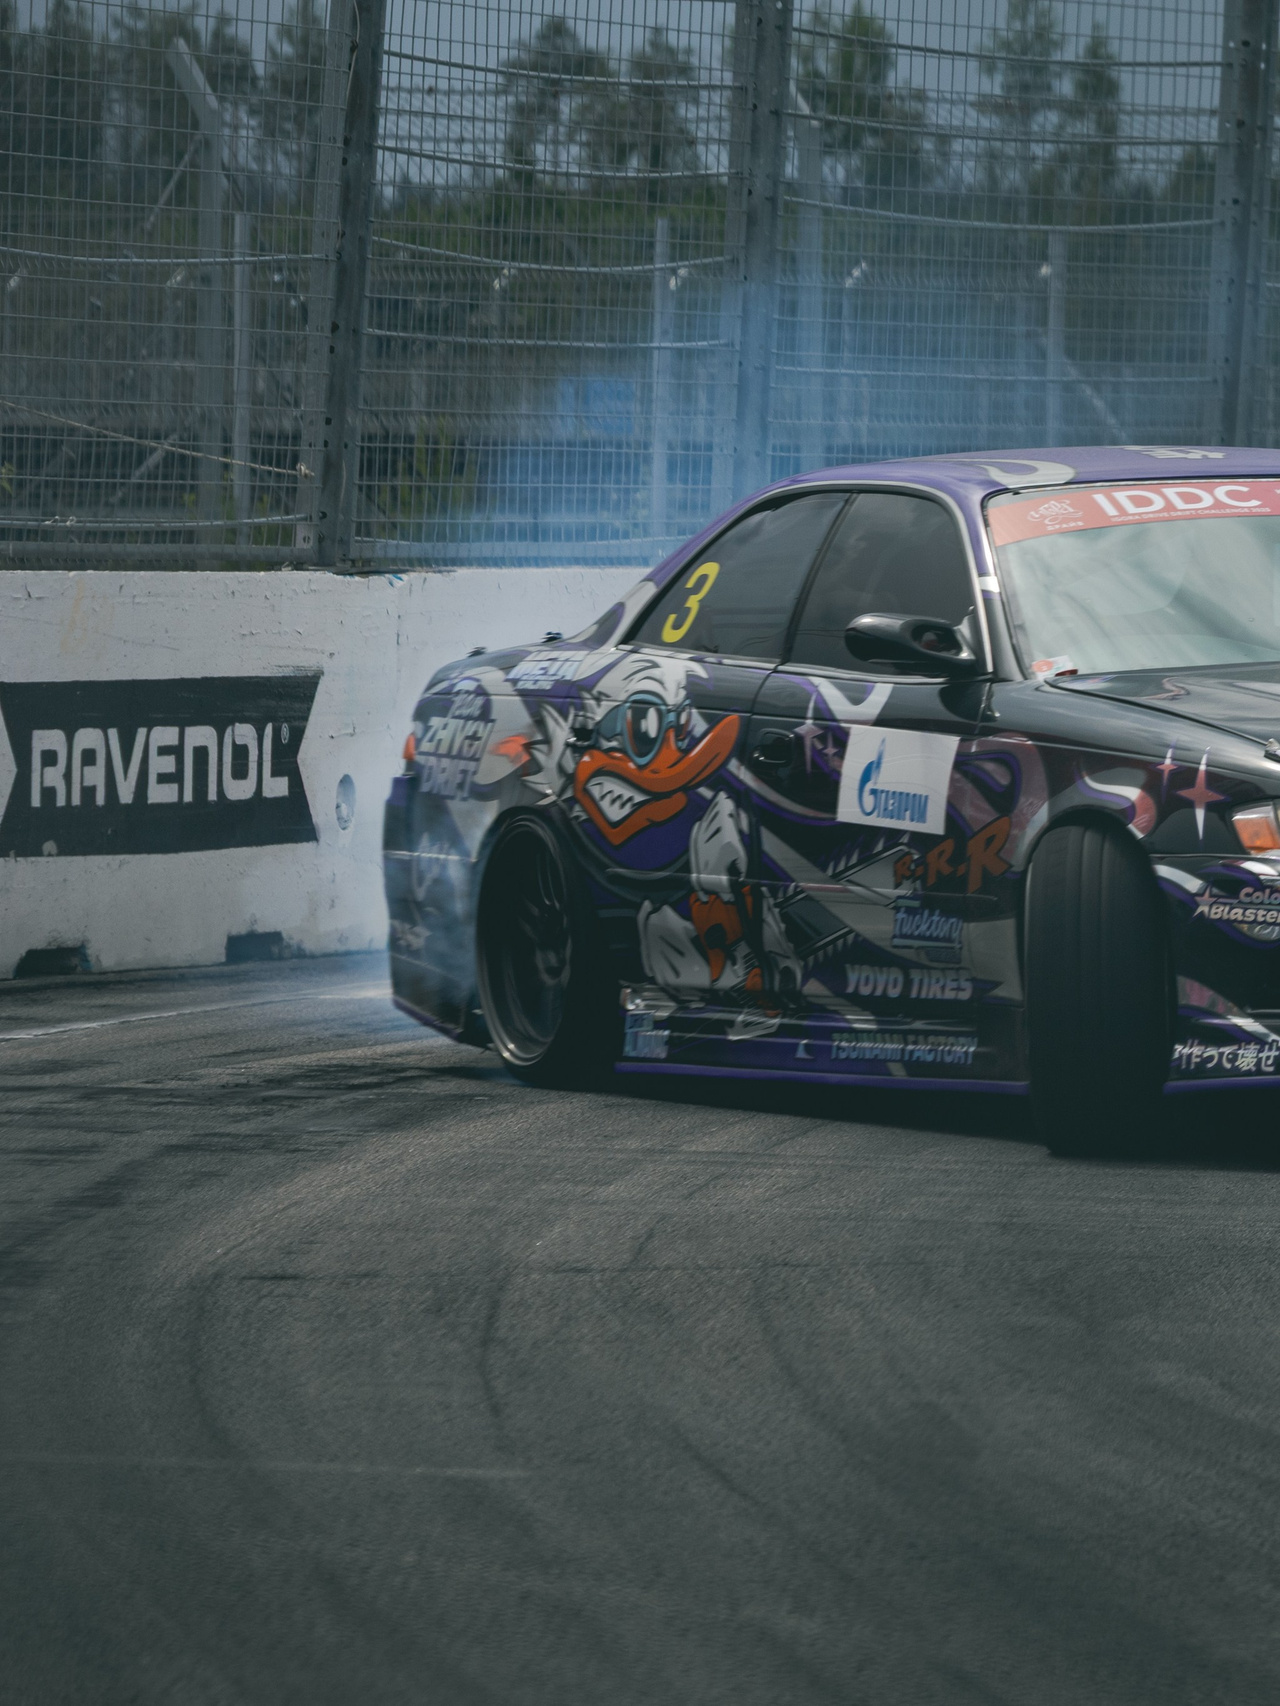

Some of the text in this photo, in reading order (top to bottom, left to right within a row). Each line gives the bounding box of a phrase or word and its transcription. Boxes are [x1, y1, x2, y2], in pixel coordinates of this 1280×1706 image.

[1092, 485, 1263, 516] IDDC
[661, 561, 720, 643] 3
[31, 722, 289, 807] RAVENOL
[845, 963, 973, 1000] YOYO TIRES
[831, 1033, 978, 1064] TSUNAMI FACTORY
